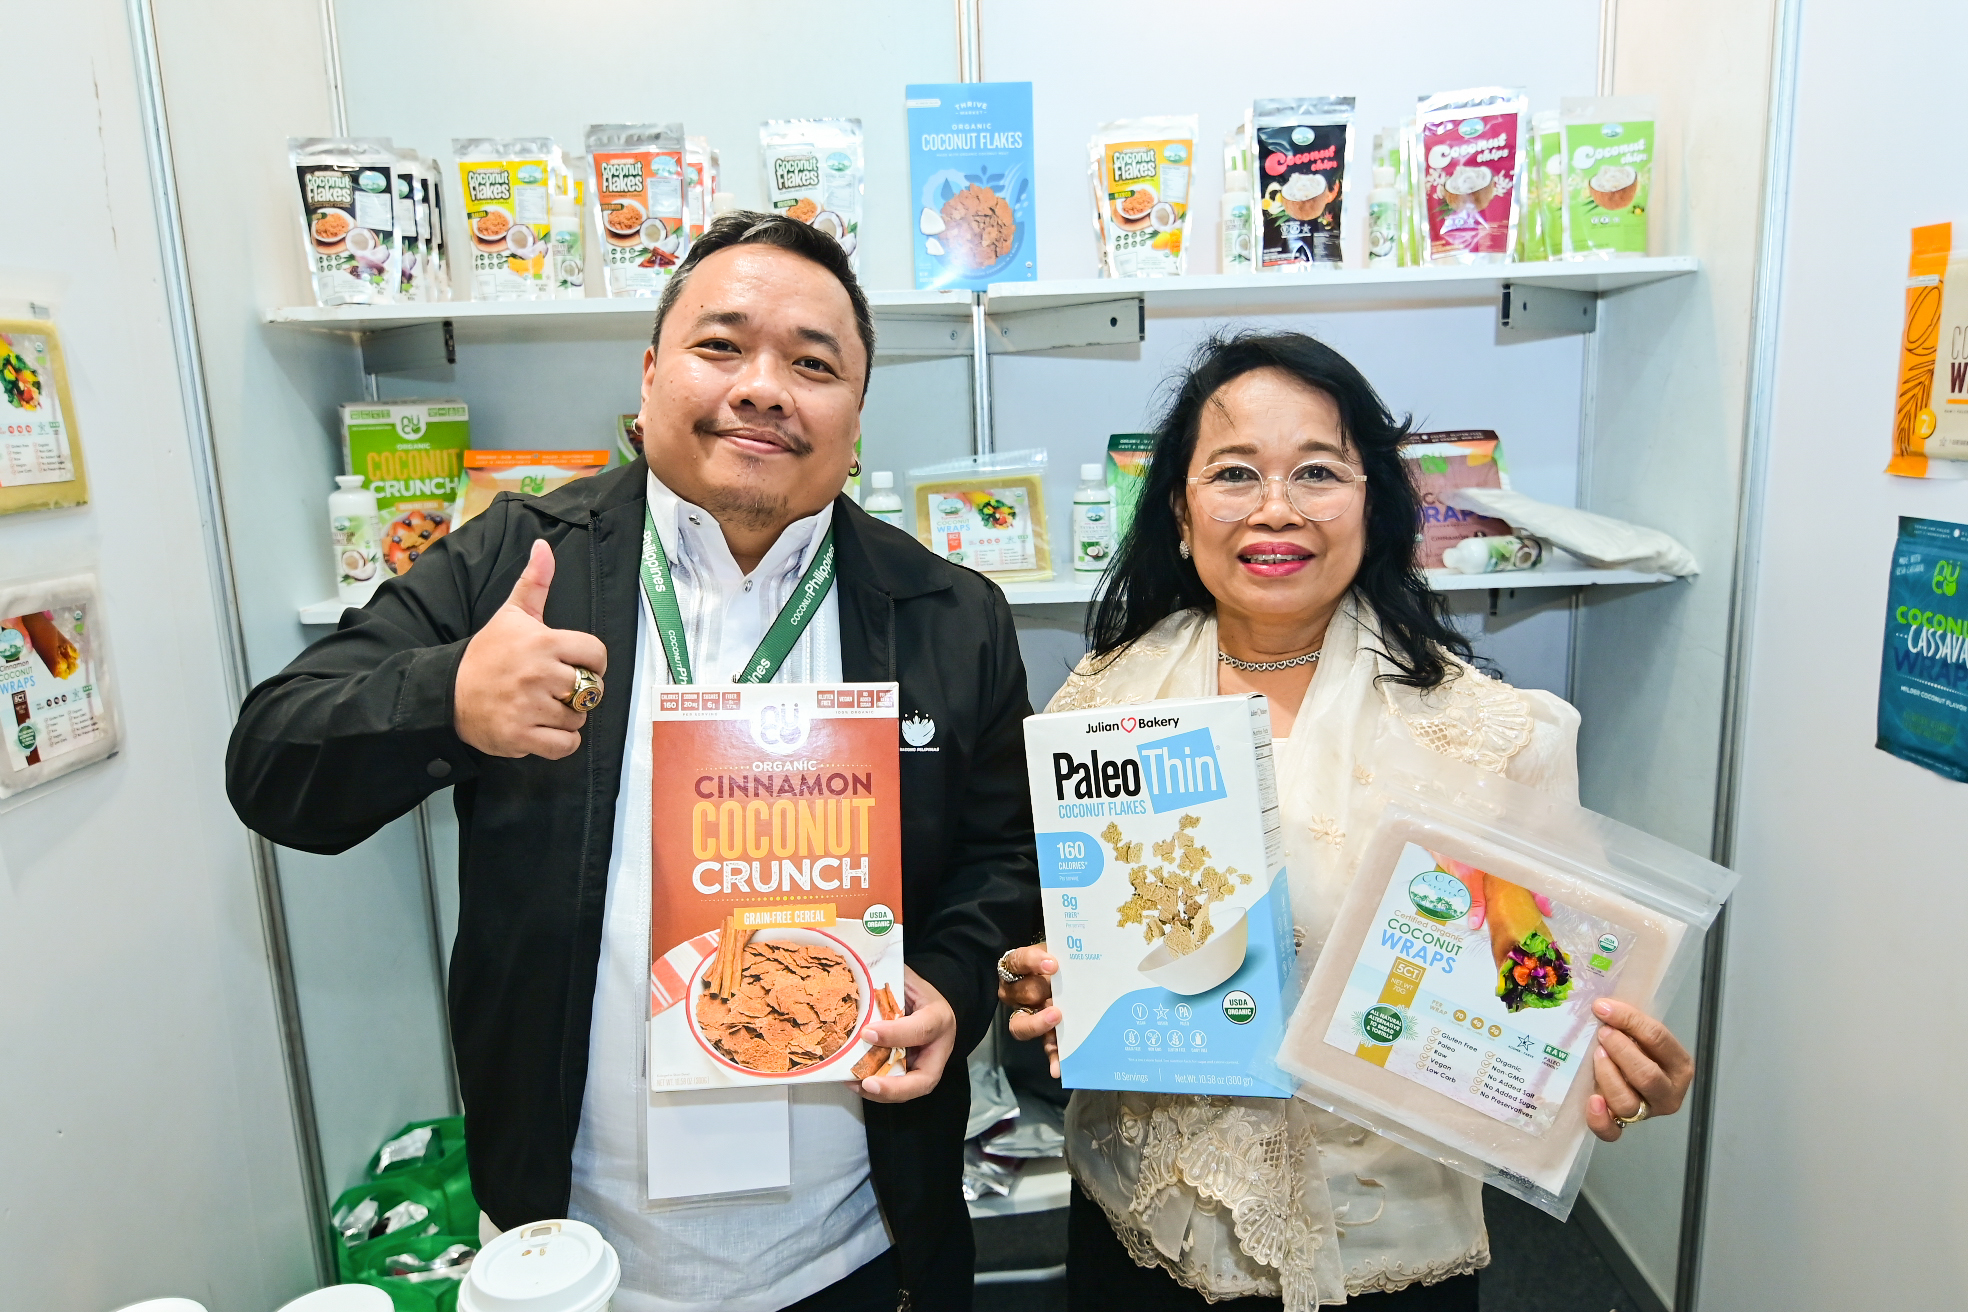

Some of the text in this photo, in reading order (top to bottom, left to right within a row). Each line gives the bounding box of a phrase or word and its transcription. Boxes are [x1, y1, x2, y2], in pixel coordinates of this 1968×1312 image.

[955, 101, 987, 110] THRIVE
[922, 131, 1023, 151] COCONUT FLAKES
[1113, 149, 1156, 164] Coconut
[1428, 133, 1507, 169] Coconut
[1476, 149, 1509, 163] chips
[1572, 138, 1647, 169] Coconut
[1621, 153, 1648, 164] chips
[775, 157, 818, 174] Coconut
[1264, 145, 1337, 176] Coconut
[1311, 160, 1339, 171] chips
[601, 161, 642, 176] Coconut
[1113, 161, 1156, 182] Flakes
[305, 173, 351, 188] Coconut
[468, 170, 509, 184] Coconut
[602, 174, 643, 193] Flakes
[776, 168, 819, 190] Flakes
[307, 186, 352, 203] Flakes
[469, 182, 510, 202] Flakes
[367, 448, 460, 481] COCONUT
[369, 477, 460, 499] CRUNCH
[937, 524, 971, 533] WRAPS
[0, 660, 30, 672] Cinnamon
[0, 675, 36, 695] WRAPS
[663, 701, 677, 709] 160
[1921, 691, 1946, 704] COCONUT
[1946, 700, 1968, 713] FLAVOR
[1085, 716, 1180, 734] Julian Bakery
[752, 760, 818, 772] ORGANIC
[1052, 745, 1218, 801] Paleo Thin
[694, 772, 872, 799] CINNAMON
[1058, 799, 1147, 819] COCONUT FLAKES
[692, 798, 876, 860] COCONUT
[1056, 841, 1085, 859] 160
[692, 857, 869, 895] CRUNCH
[1422, 874, 1467, 898] COCO
[1061, 893, 1078, 911] 8g
[743, 910, 826, 925] GRAIN-FREE CEREAL
[869, 911, 888, 919] USDA
[867, 920, 890, 928] ORGANIC
[1393, 909, 1464, 943] Certified Organic
[1066, 935, 1083, 952] 0g
[1387, 918, 1463, 956] COCONUT
[1069, 953, 1084, 961] ADDED
[1381, 929, 1457, 974] WRAPS
[1396, 964, 1420, 979] 5CT
[1392, 985, 1407, 995] 70G
[1228, 998, 1249, 1006] USDA
[1431, 1000, 1443, 1008] PER
[1178, 1006, 1190, 1018] PA
[1227, 1008, 1252, 1016] ORGANIC
[1369, 1009, 1402, 1027] ALL NATURAL
[1429, 1005, 1448, 1016] WRAP
[1455, 1011, 1464, 1020] 70
[1367, 1014, 1401, 1032] ALTERNATIVE
[1377, 1023, 1395, 1035] BREAD
[1472, 1019, 1482, 1028] 4g
[1371, 1028, 1393, 1041] TORTILLA
[1489, 1026, 1500, 1036] 2g
[1437, 1040, 1456, 1053] Paleo
[1441, 1032, 1478, 1053] Gluten Free
[1433, 1049, 1448, 1059] Raw
[1545, 1045, 1568, 1059] RAW
[1430, 1057, 1452, 1071] Vegan
[1495, 1057, 1522, 1073] Organic
[1543, 1056, 1561, 1067] PALEO
[1113, 1071, 1149, 1083] 10 Servings
[1199, 1074, 1216, 1084] 10.58
[1217, 1077, 1225, 1085] oz
[1225, 1075, 1242, 1086] (300
[1243, 1076, 1253, 1087] gr)
[1426, 1065, 1457, 1083] Low Carb
[1491, 1065, 1525, 1084] Non-GMO
[656, 1078, 665, 1087] NET
[1487, 1073, 1535, 1099] No Added Salt
[1484, 1082, 1538, 1111] No Added Sugar
[1479, 1091, 1533, 1119] No Preservatives
